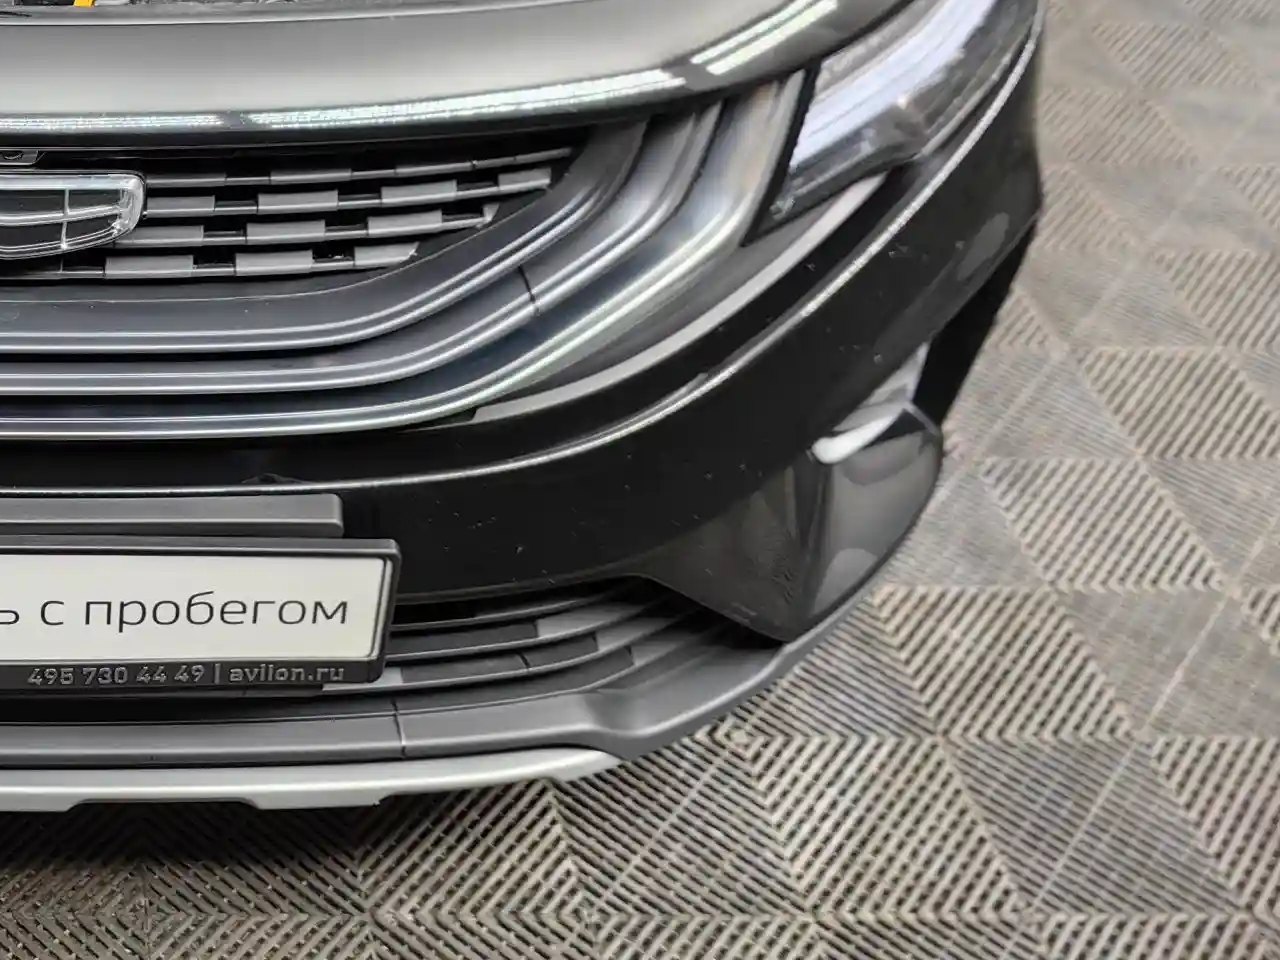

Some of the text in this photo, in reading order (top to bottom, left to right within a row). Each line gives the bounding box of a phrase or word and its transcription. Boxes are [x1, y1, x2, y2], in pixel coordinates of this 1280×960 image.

[40, 600, 65, 625] с
[84, 591, 348, 633] пробегом
[27, 668, 74, 685] 495
[82, 667, 129, 685] 730
[136, 665, 167, 683] 44
[174, 664, 205, 683] 49
[229, 663, 345, 682] avilon.ru
